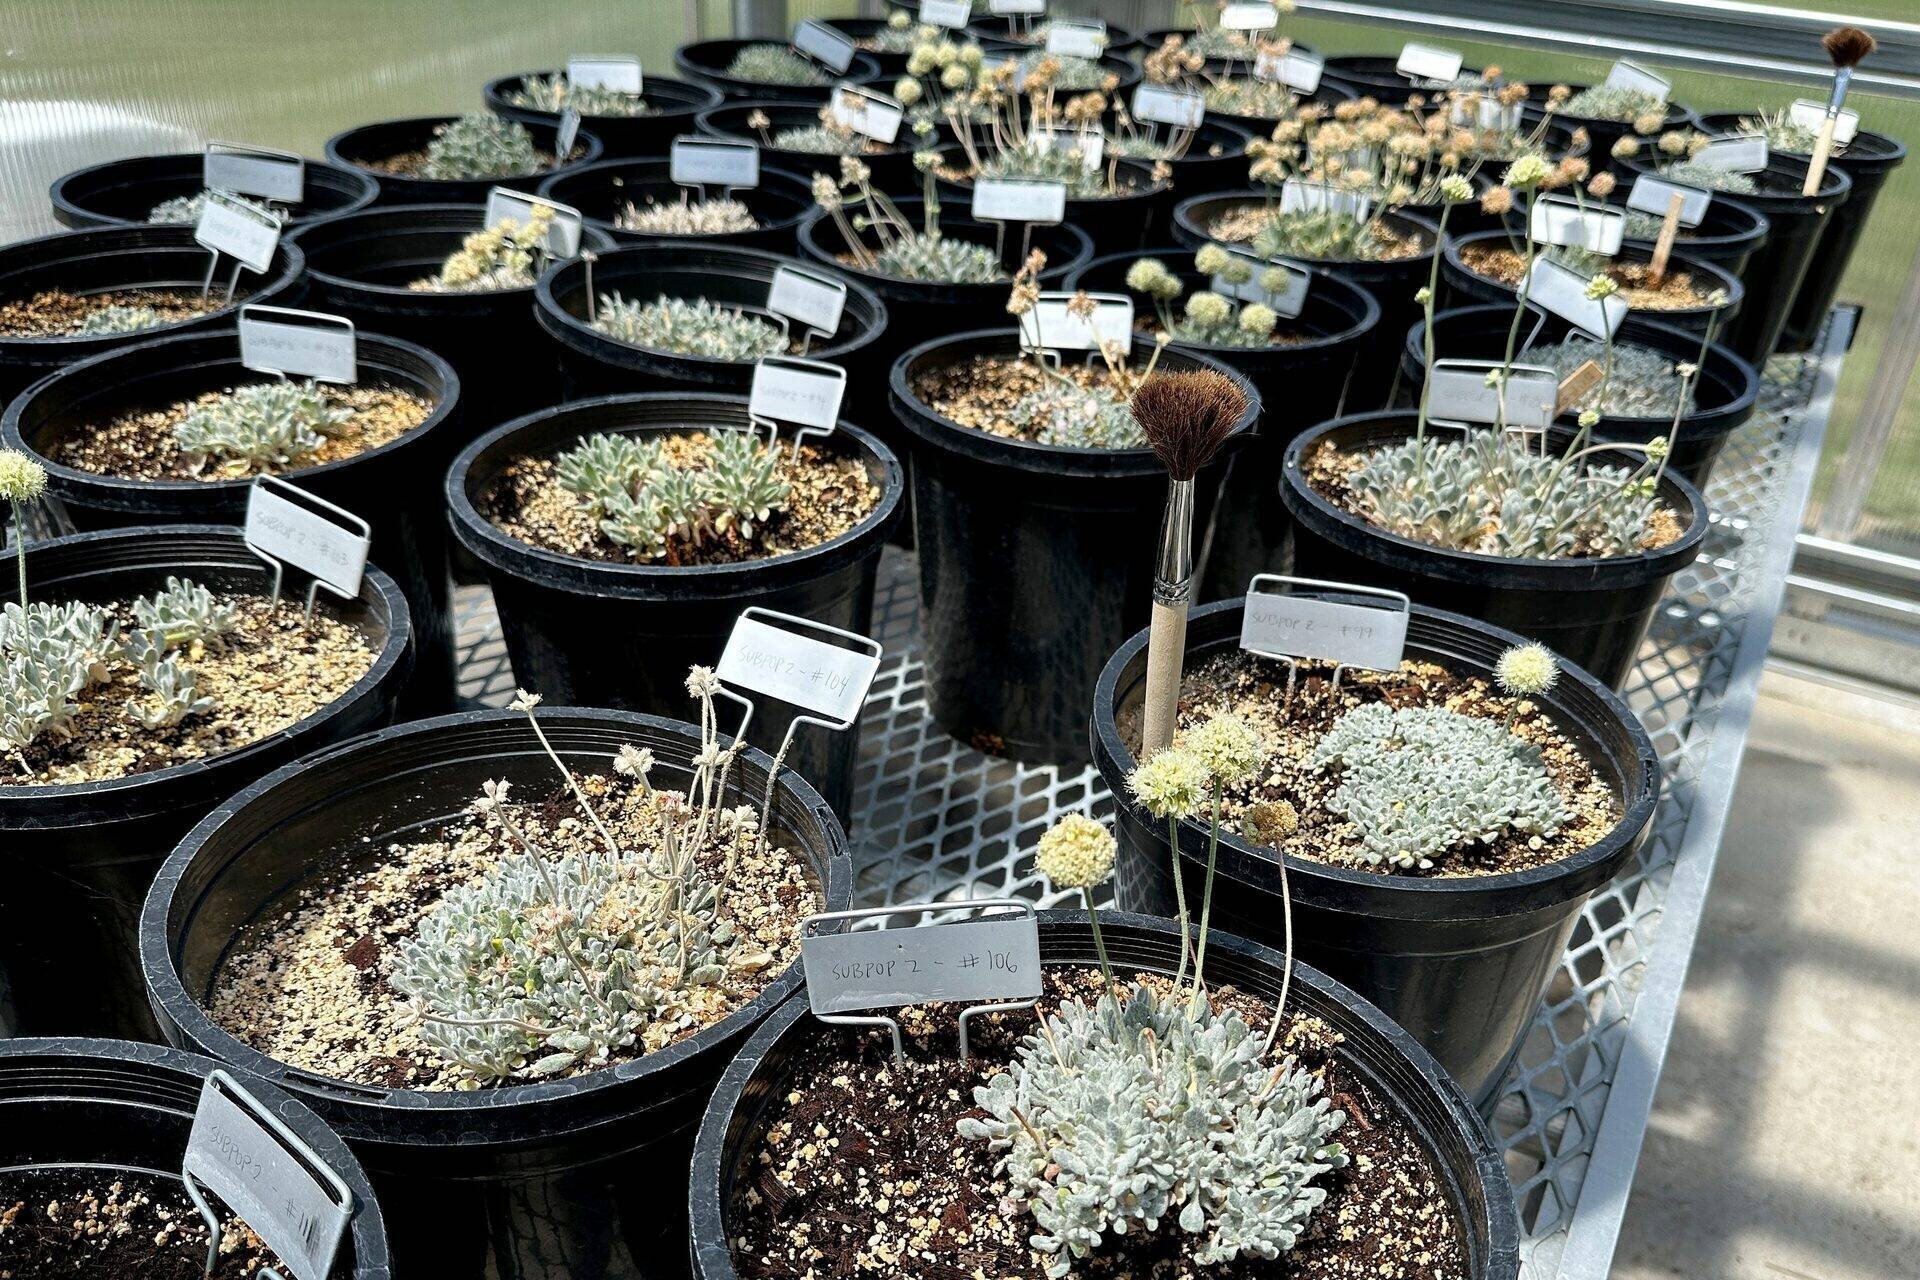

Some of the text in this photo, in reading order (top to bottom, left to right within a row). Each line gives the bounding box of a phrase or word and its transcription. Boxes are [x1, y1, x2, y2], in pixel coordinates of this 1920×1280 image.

[1249, 613, 1301, 630] SUBPOP
[1303, 619, 1315, 632] 2
[736, 643, 785, 673] SUBPOP
[784, 661, 796, 674] 2
[809, 664, 850, 698] #104
[831, 959, 896, 981] SUBPOP
[904, 959, 922, 973] 2
[957, 949, 1018, 974] #106
[209, 1125, 252, 1171] SUBPOP
[252, 1163, 263, 1183] 2
